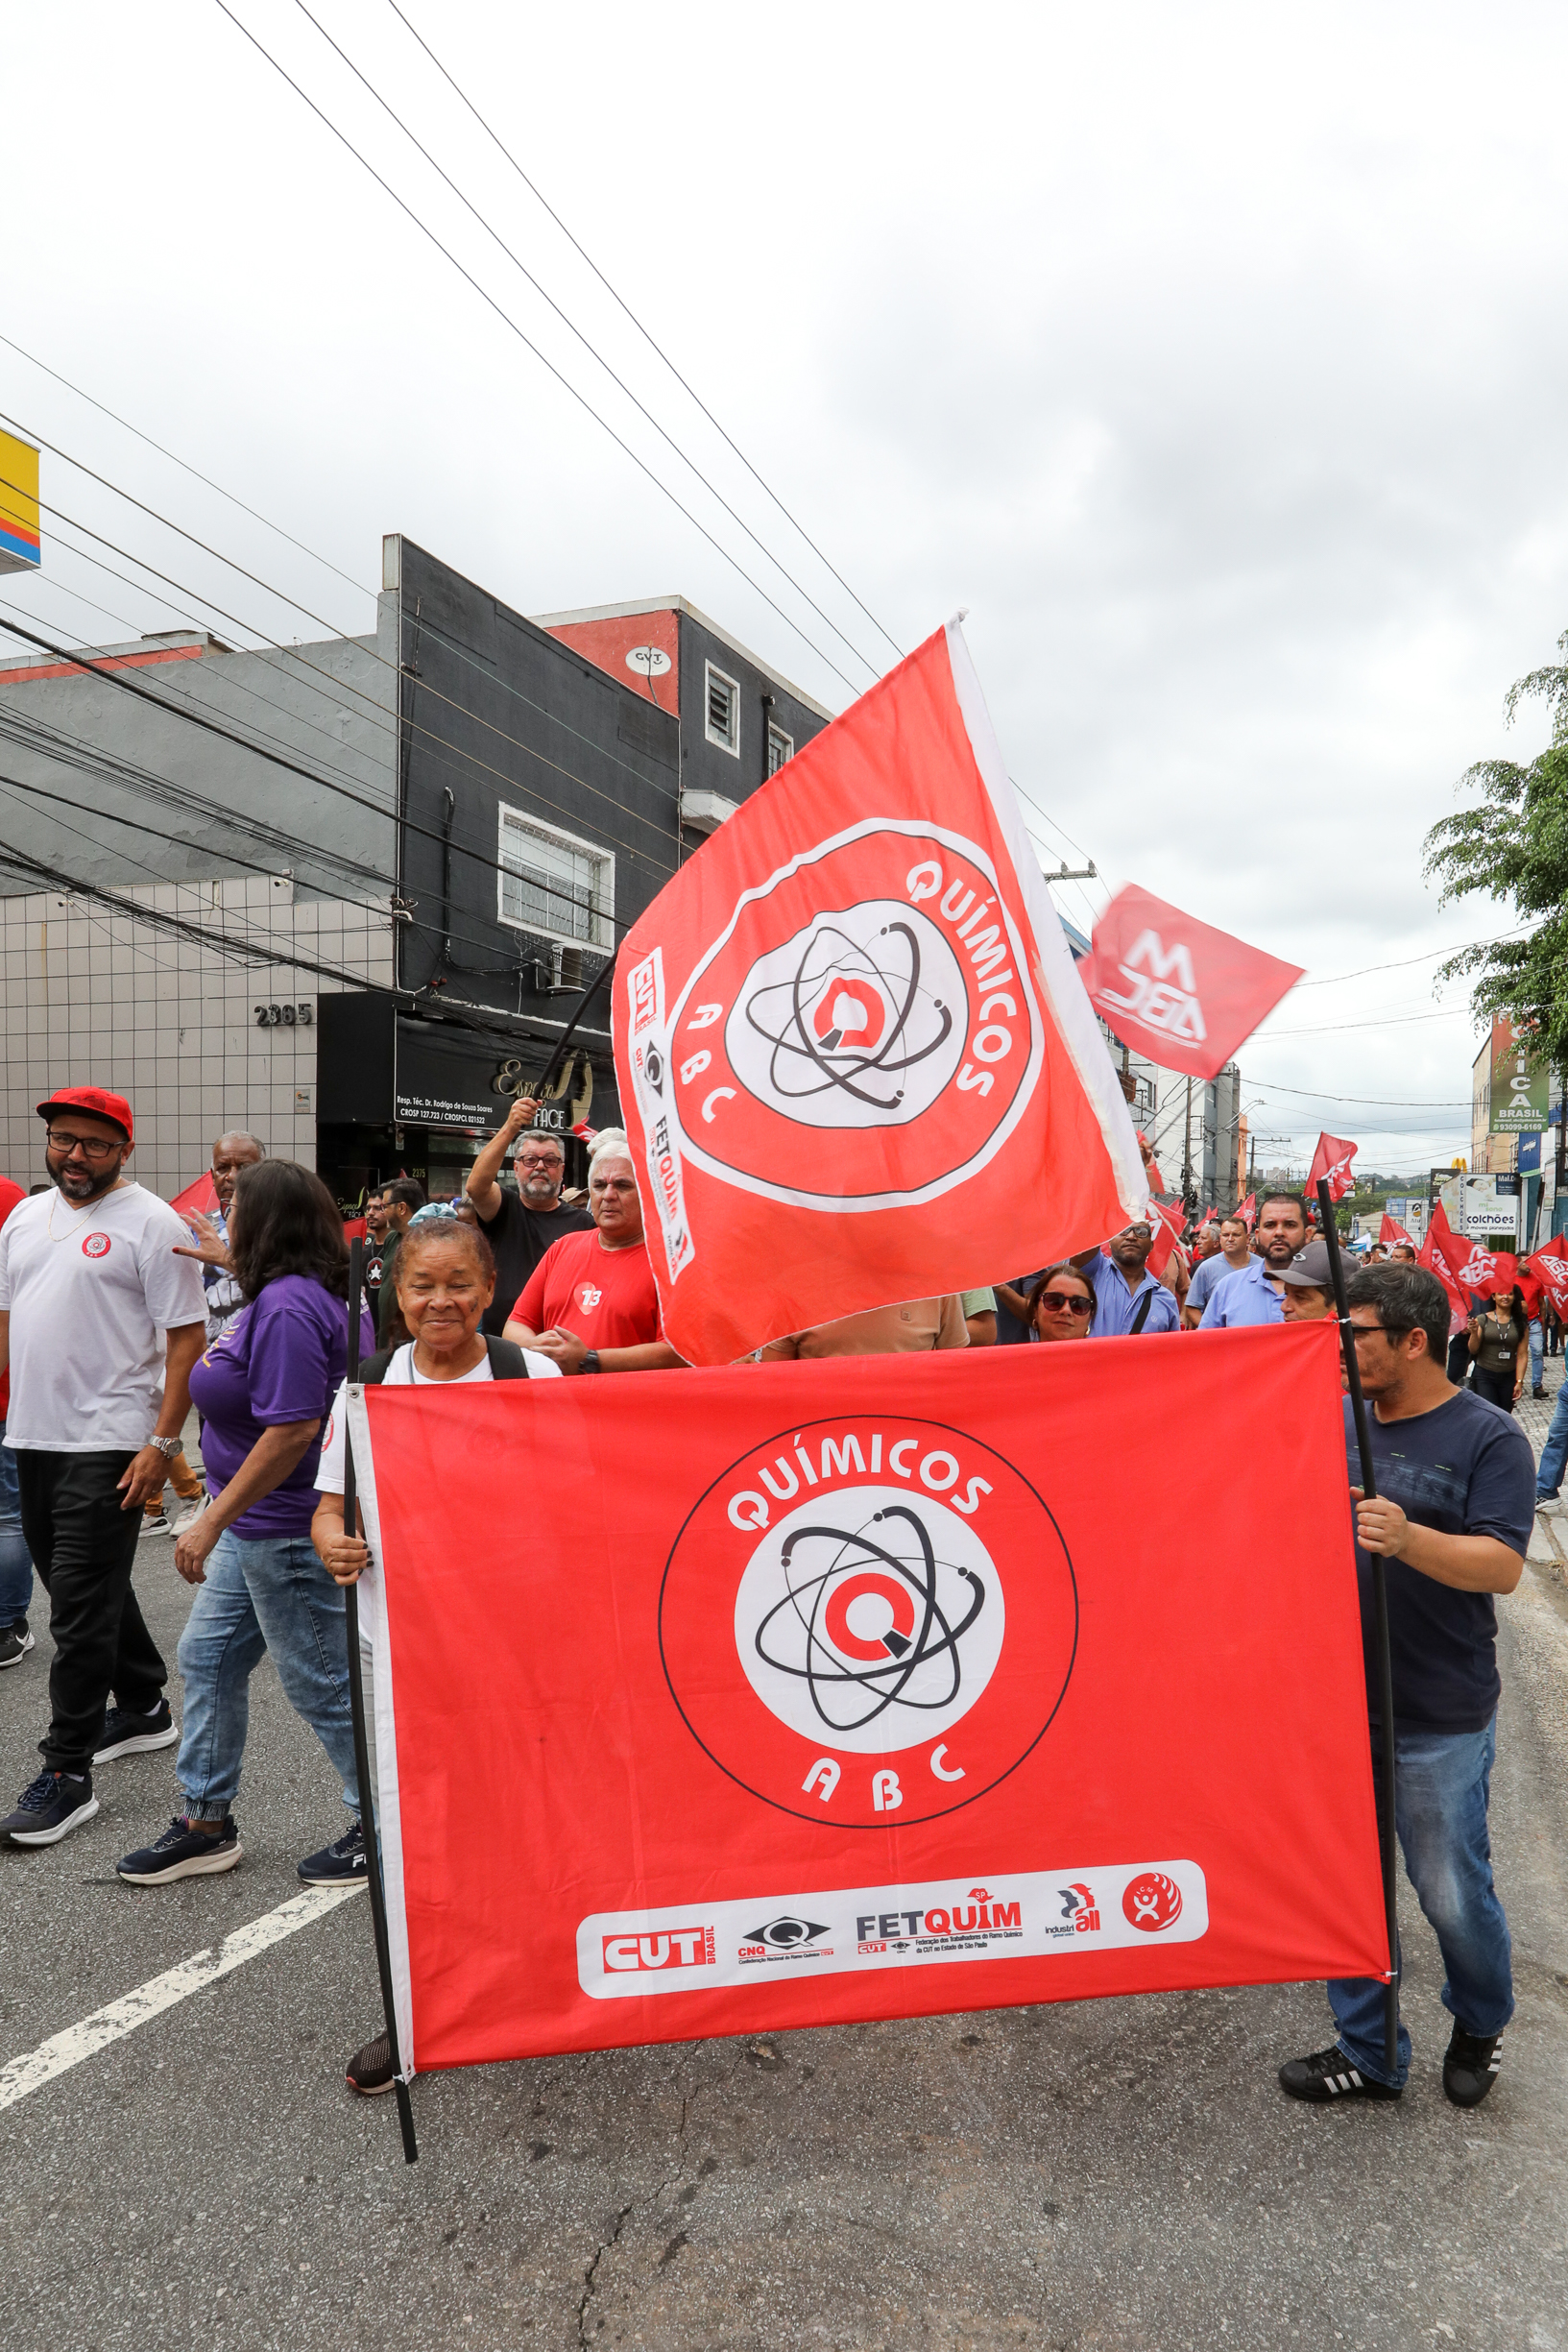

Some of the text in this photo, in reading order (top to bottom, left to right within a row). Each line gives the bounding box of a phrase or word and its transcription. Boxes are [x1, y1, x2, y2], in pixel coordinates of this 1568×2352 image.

[905, 860, 1015, 1097] QUÍMICOS
[636, 963, 655, 1024] CUT
[397, 1095, 412, 1105] Resp.
[413, 1097, 424, 1105] Téc.
[433, 1100, 453, 1110] Rodrigo
[454, 1102, 461, 1110] de
[462, 1103, 476, 1111] Souza
[477, 1104, 493, 1113] Soares
[400, 1108, 420, 1117] CROSP
[534, 1107, 566, 1129] FACE
[1499, 1108, 1543, 1118] BRASIL
[412, 1168, 426, 1178] 2375
[1466, 1214, 1514, 1224] colchões
[582, 1289, 602, 1307] 13
[727, 1433, 994, 1532] QUÍMICOS
[975, 1891, 986, 1900] SP
[706, 1926, 716, 1965] BRASIL
[858, 1943, 883, 1953] CUT
[916, 1937, 939, 1946] Federação
[604, 1931, 702, 1970] CUT
[738, 1946, 766, 1956] CNQ
